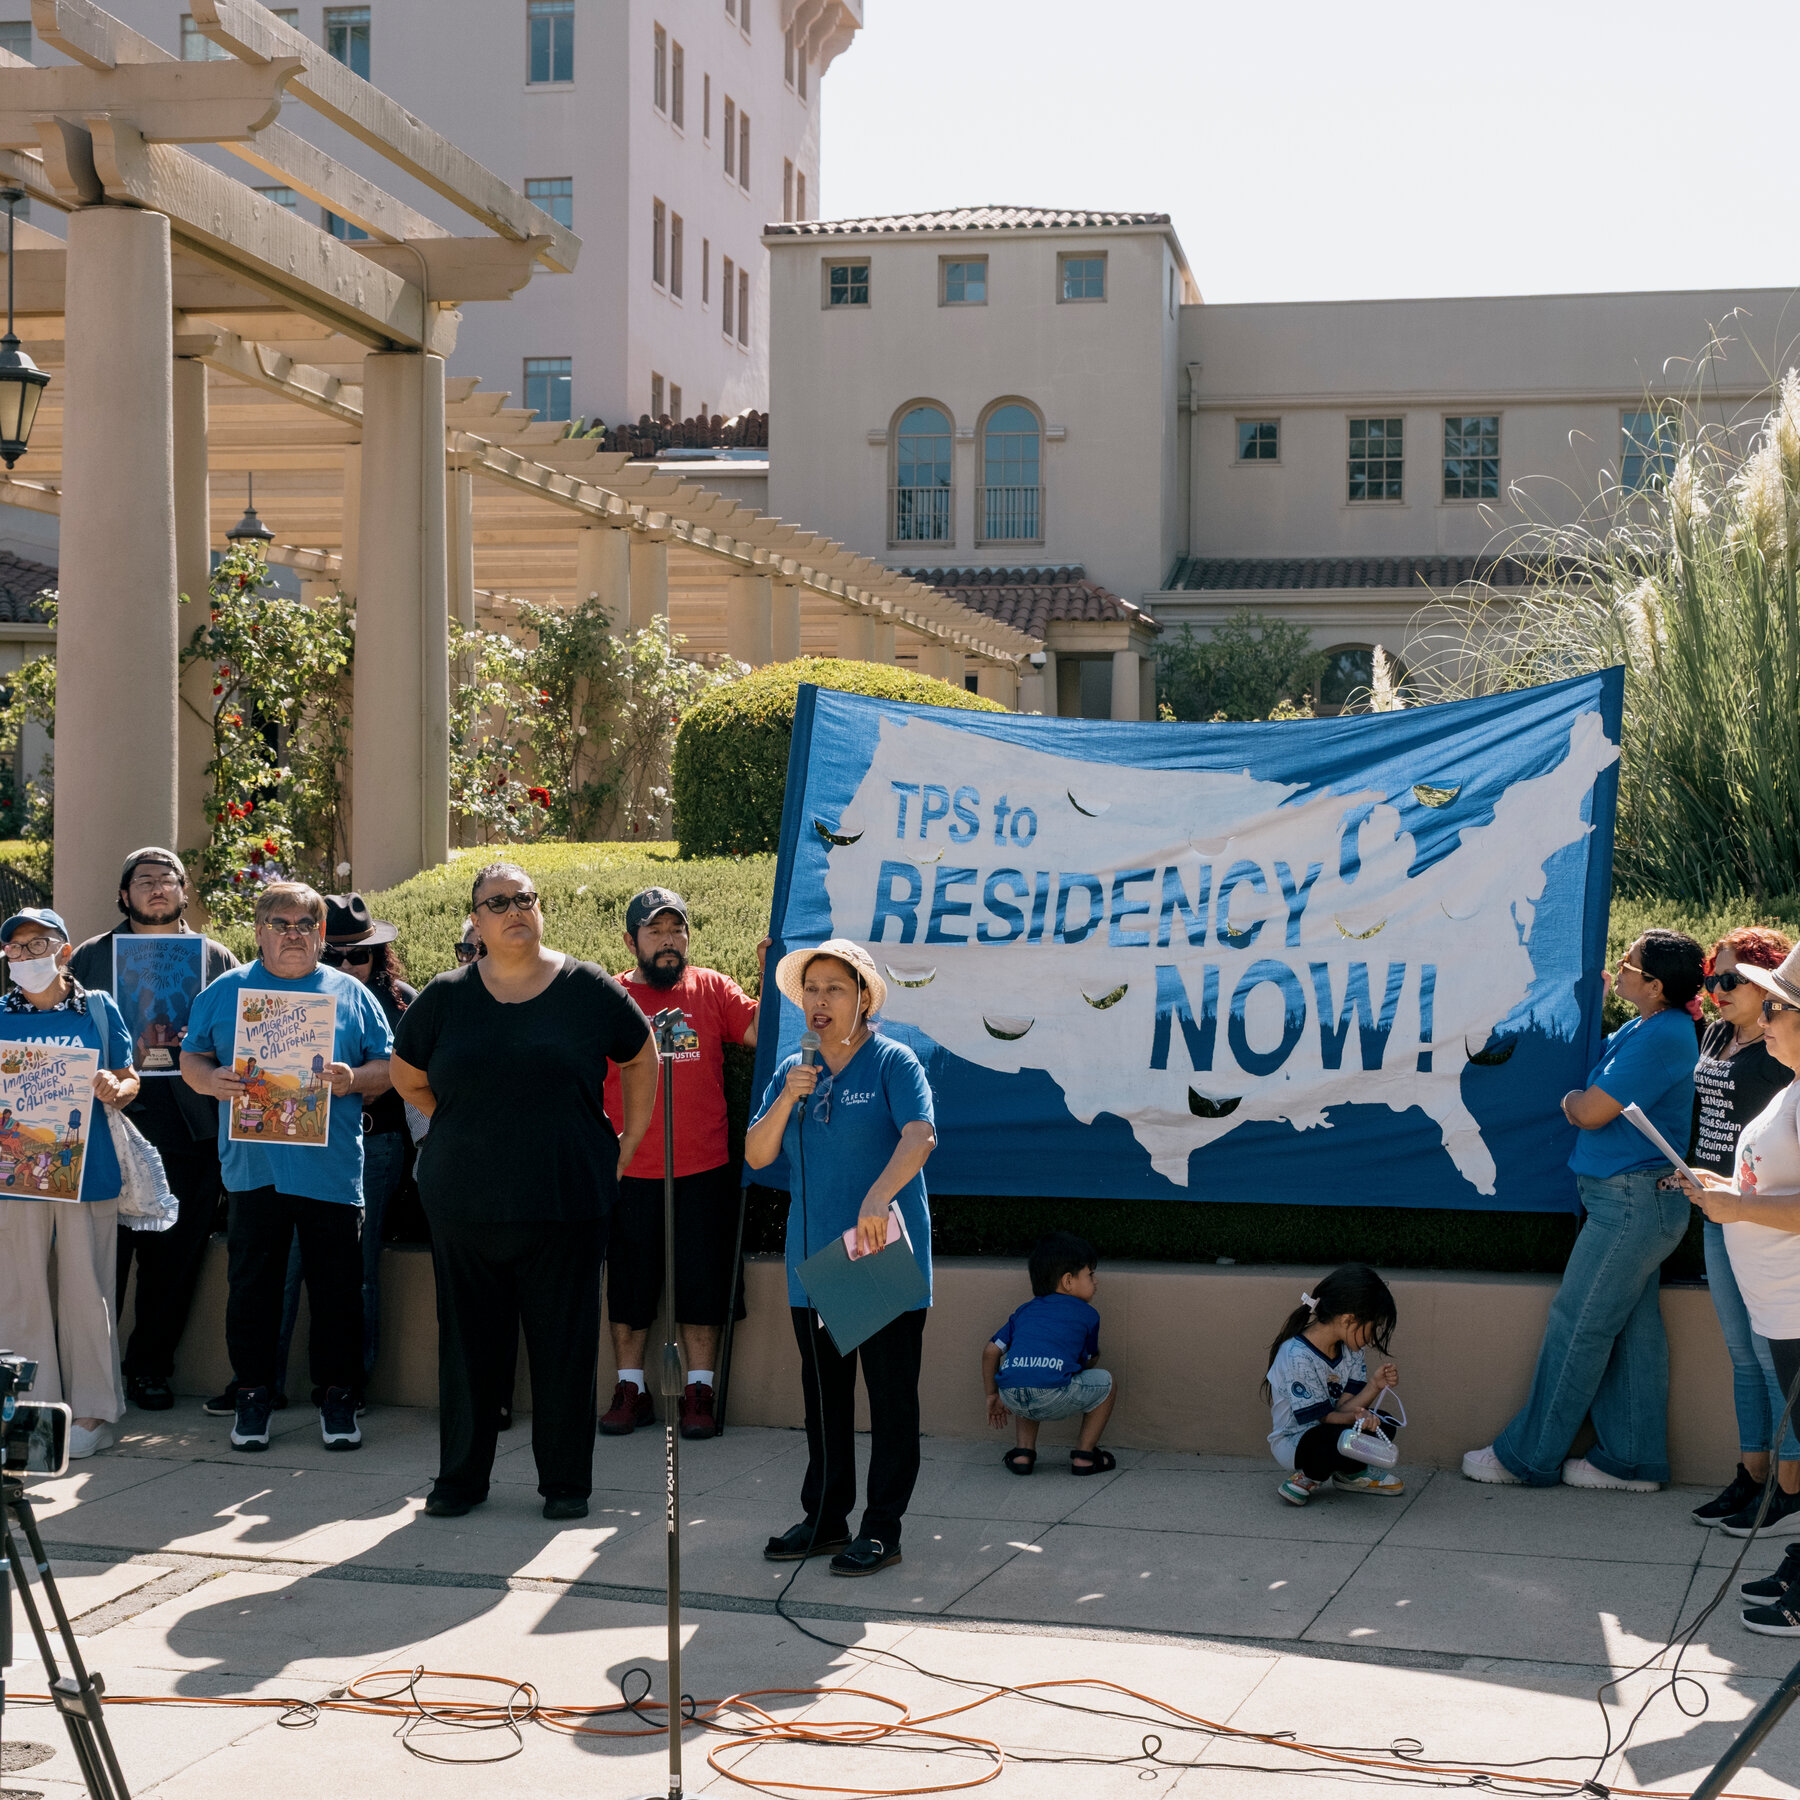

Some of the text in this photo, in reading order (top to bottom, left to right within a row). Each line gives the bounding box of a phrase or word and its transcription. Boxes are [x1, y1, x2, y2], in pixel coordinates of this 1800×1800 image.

[891, 781, 1037, 847] TPS to
[869, 860, 1323, 949] RESIDENCY
[246, 1006, 307, 1042] IMMIGRANTS
[1149, 959, 1437, 1076] NOW!
[260, 1029, 316, 1060] CALIFORNIA
[263, 1022, 301, 1046] POWER
[2, 1060, 66, 1093] IMMIGRANTS
[20, 1075, 60, 1098] POWER
[16, 1083, 75, 1112] CALIFORNIA
[841, 1092, 876, 1103] CARECEN
[1011, 1356, 1064, 1371] SALVADOR
[666, 1426, 675, 1533] ULTIMATE
